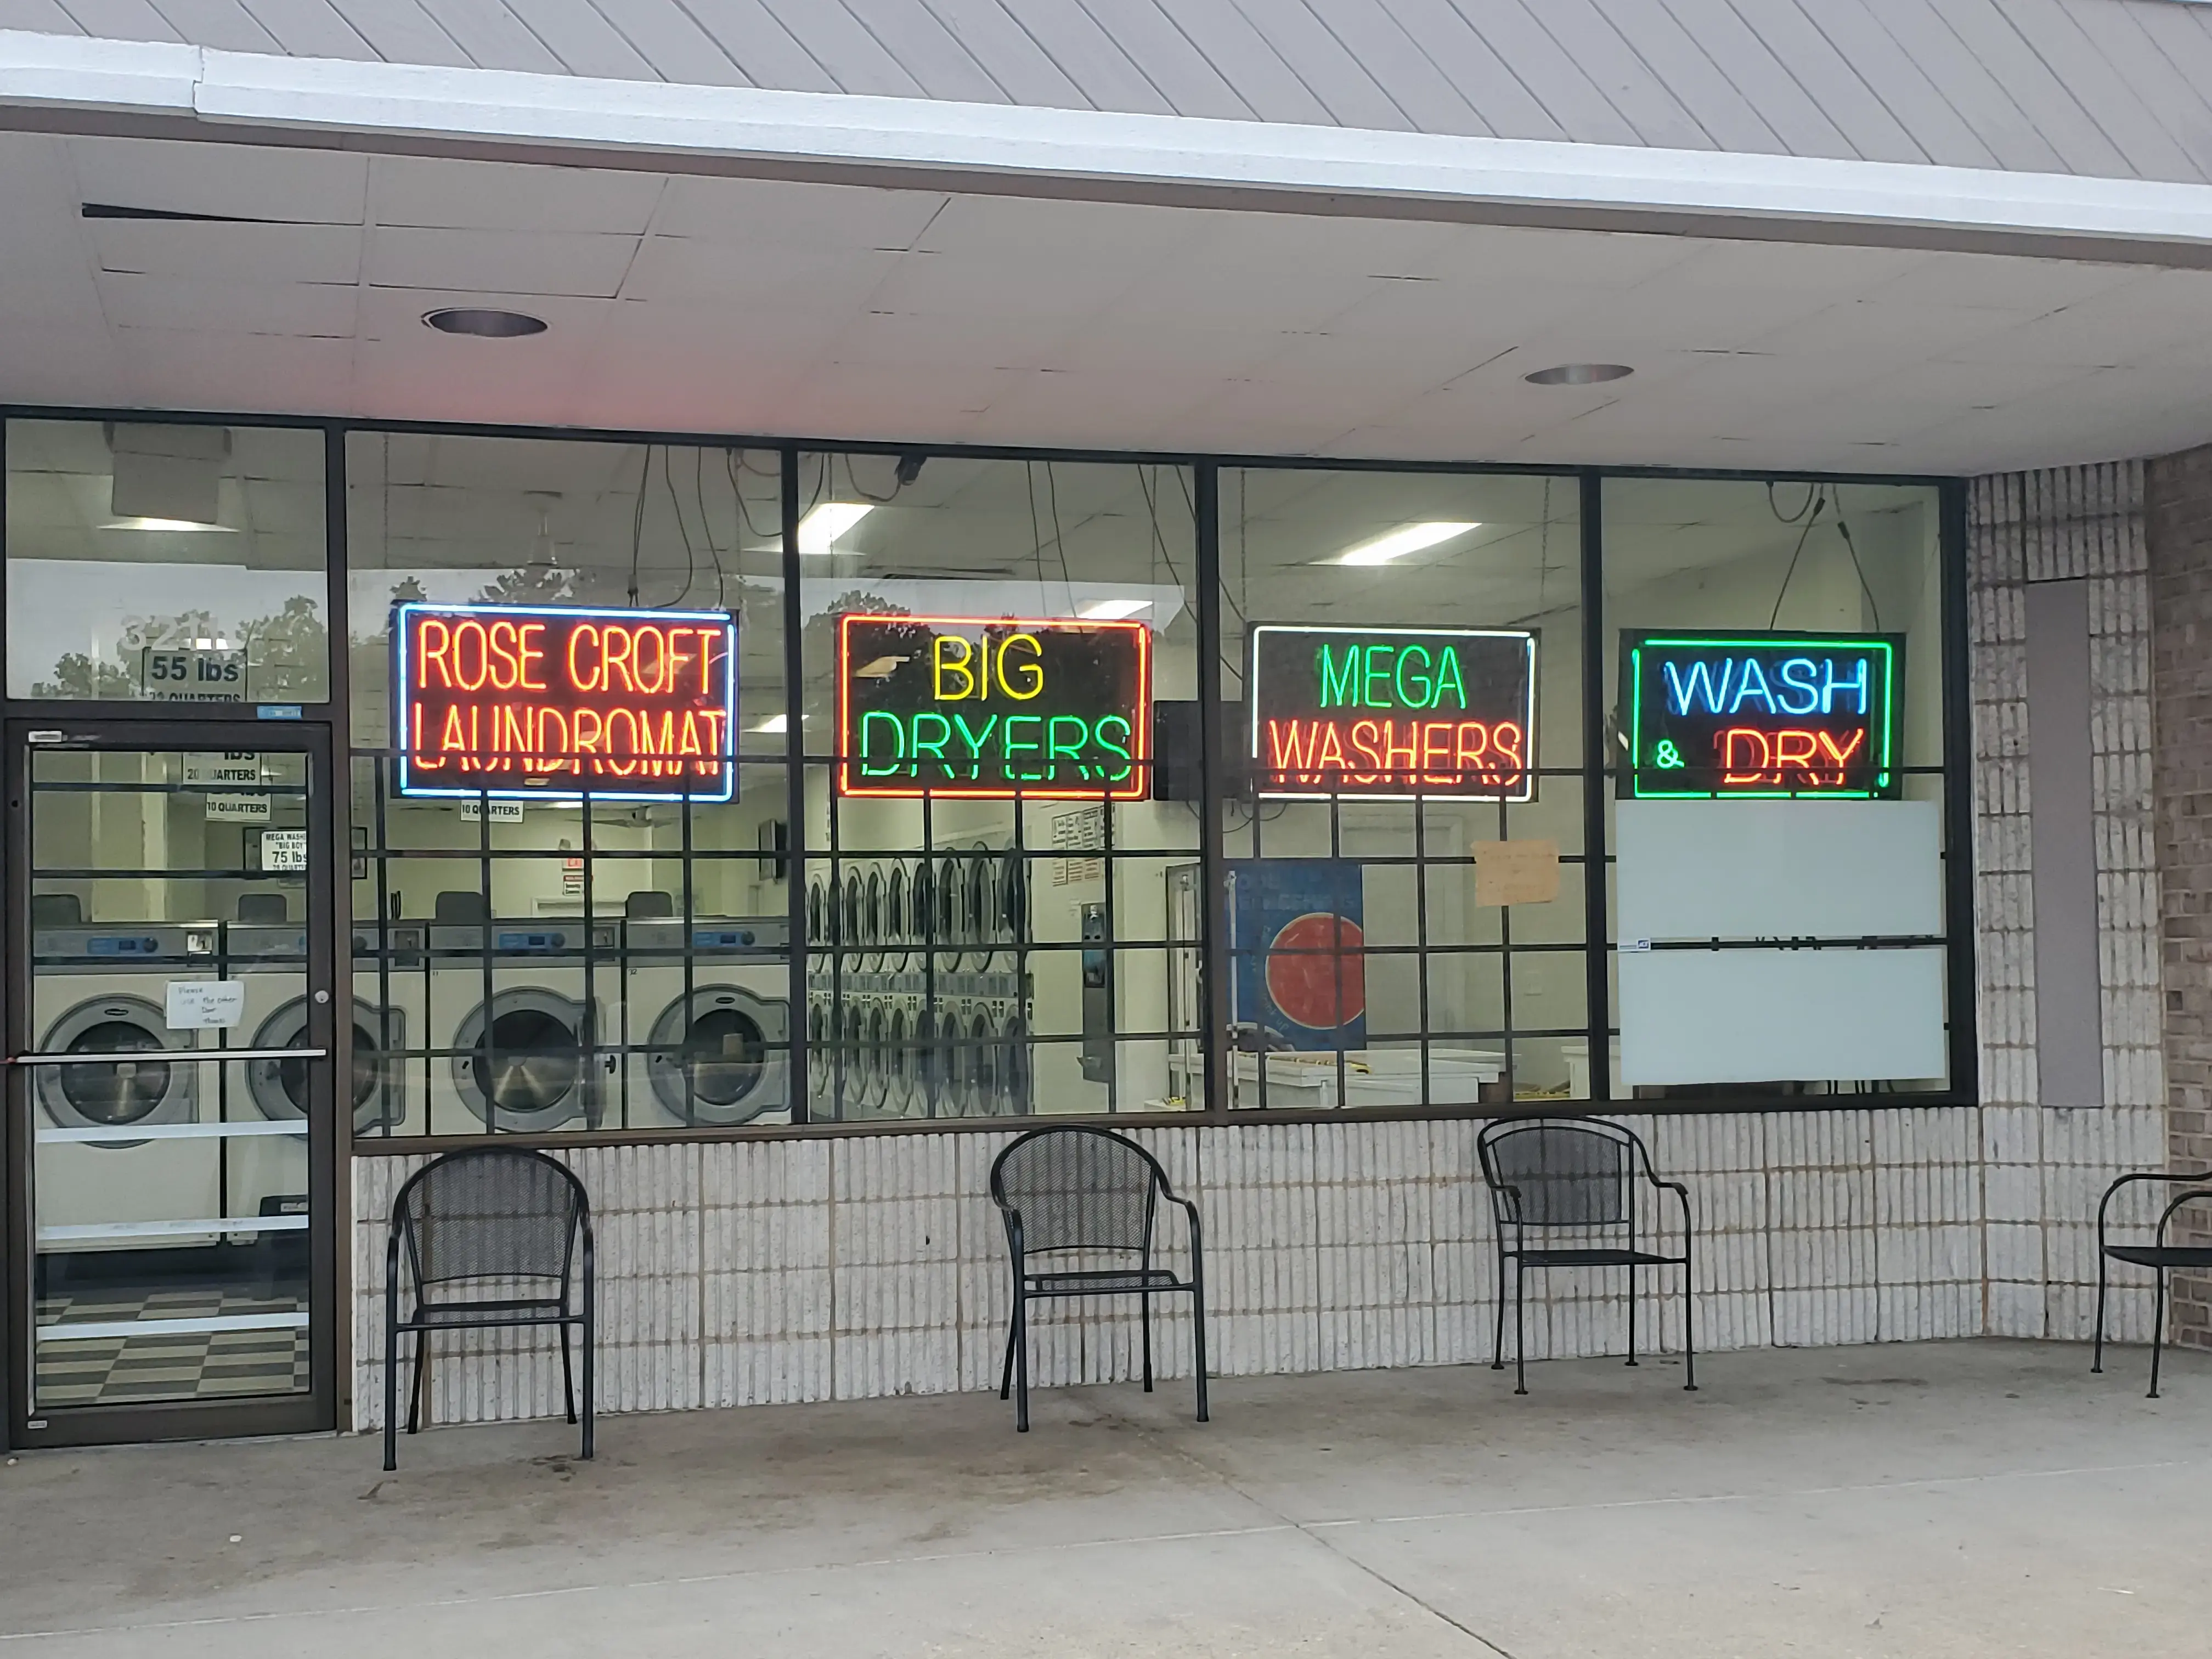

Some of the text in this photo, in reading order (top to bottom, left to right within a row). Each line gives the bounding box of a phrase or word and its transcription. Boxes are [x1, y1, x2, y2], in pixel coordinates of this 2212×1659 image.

[151, 656, 239, 681] 55 lbs
[419, 619, 721, 695] ROSE CROFT
[934, 634, 1044, 701] BIG
[1320, 644, 1467, 709] MEGA
[1664, 658, 1867, 716] WASH
[414, 702, 727, 777] LAUNDROMAT
[860, 710, 1132, 781] DRYERS
[1268, 719, 1522, 786] WASHERS
[1656, 728, 1865, 785] & DRY
[187, 769, 199, 780] 20
[207, 802, 268, 814] 10 QUARTERS
[462, 804, 520, 816] 10 QRTERS
[272, 851, 288, 863] 75
